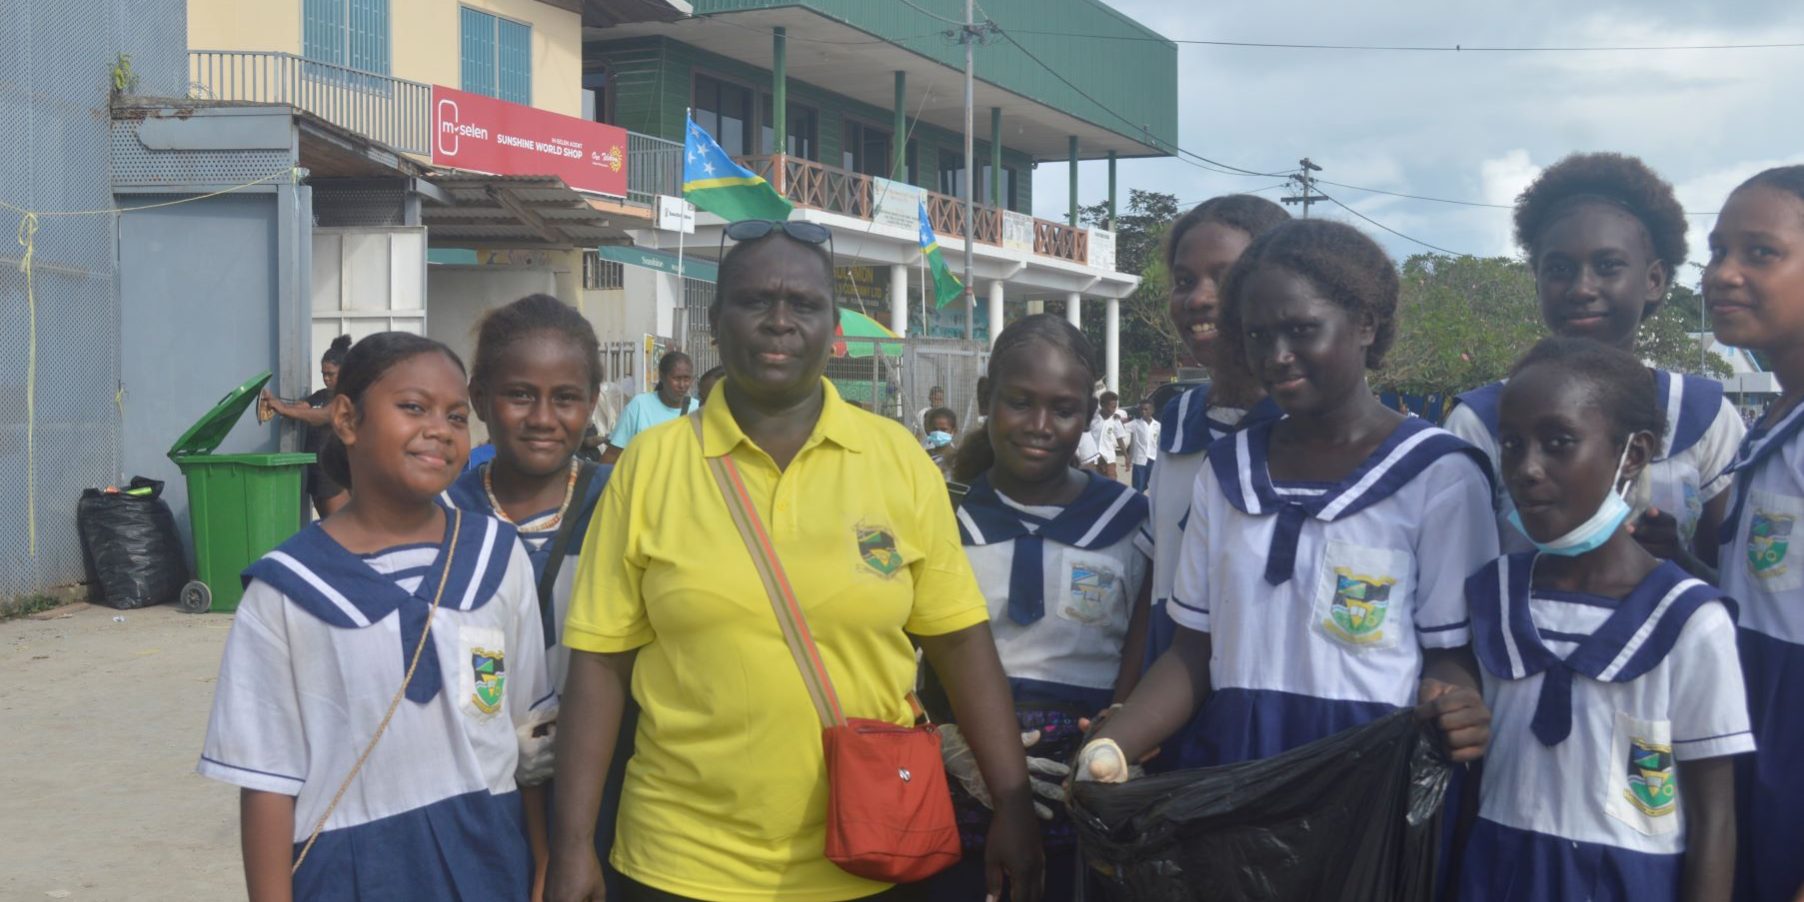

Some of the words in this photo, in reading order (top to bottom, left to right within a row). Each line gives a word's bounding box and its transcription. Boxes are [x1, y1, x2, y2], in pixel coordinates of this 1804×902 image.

[497, 134, 534, 150] SUNSHINE
[536, 142, 562, 155] WORLD
[563, 147, 583, 159] SHOP
